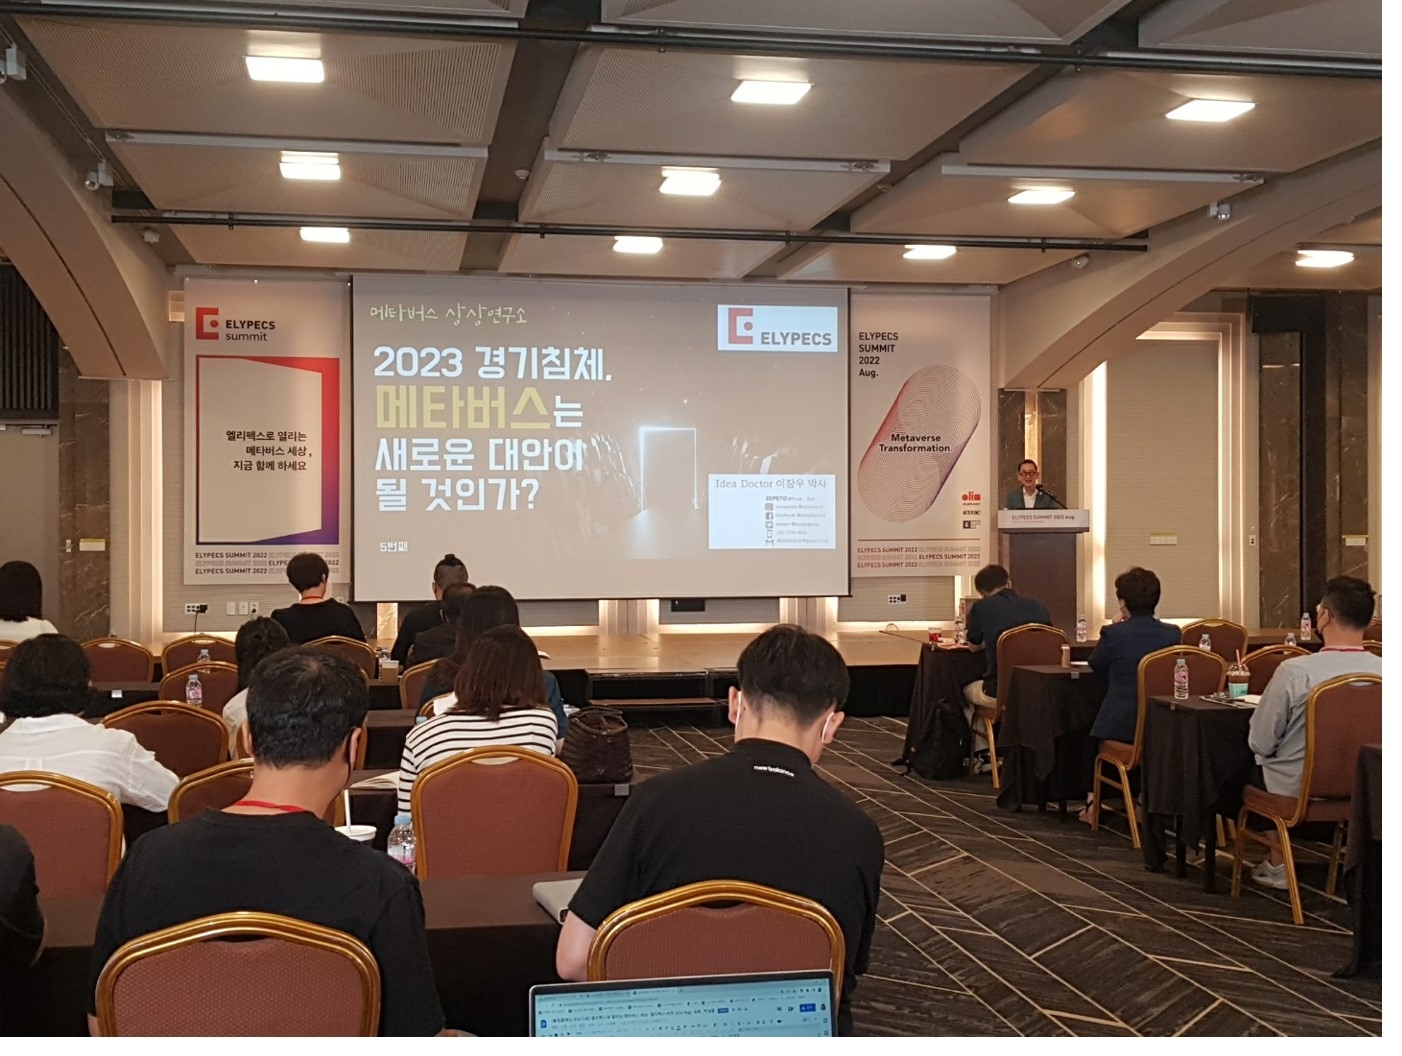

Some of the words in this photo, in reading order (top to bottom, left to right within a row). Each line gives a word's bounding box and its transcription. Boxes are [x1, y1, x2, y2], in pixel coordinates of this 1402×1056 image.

[370, 303, 438, 322] 메타버스
[445, 302, 527, 326] 상상연구소
[225, 319, 276, 330] ELYPECS
[225, 331, 268, 341] summit
[760, 331, 832, 346] ELYPECS
[858, 331, 899, 341] ELYPECS
[858, 344, 896, 353] SUMMIT
[373, 345, 464, 378] 2023
[475, 346, 613, 382] 경기침체.
[858, 356, 880, 365] 2022
[858, 367, 879, 379] Aug.
[376, 385, 584, 429] 메타버스는
[226, 430, 276, 441] 엘리펙스로
[277, 430, 308, 442] 열리는
[890, 433, 942, 442] Metaverse
[245, 445, 286, 457] 메타버스
[375, 437, 475, 471] 새로운
[488, 437, 585, 472] 대안이
[233, 460, 254, 471] 지금
[256, 460, 275, 471] 함께
[277, 460, 308, 471] 하세요
[715, 479, 738, 489] Idea
[741, 479, 774, 489] Doctor
[808, 478, 828, 489] 박사
[375, 478, 408, 512] 될
[421, 477, 541, 512] 것인가?
[379, 540, 409, 553] 5번째
